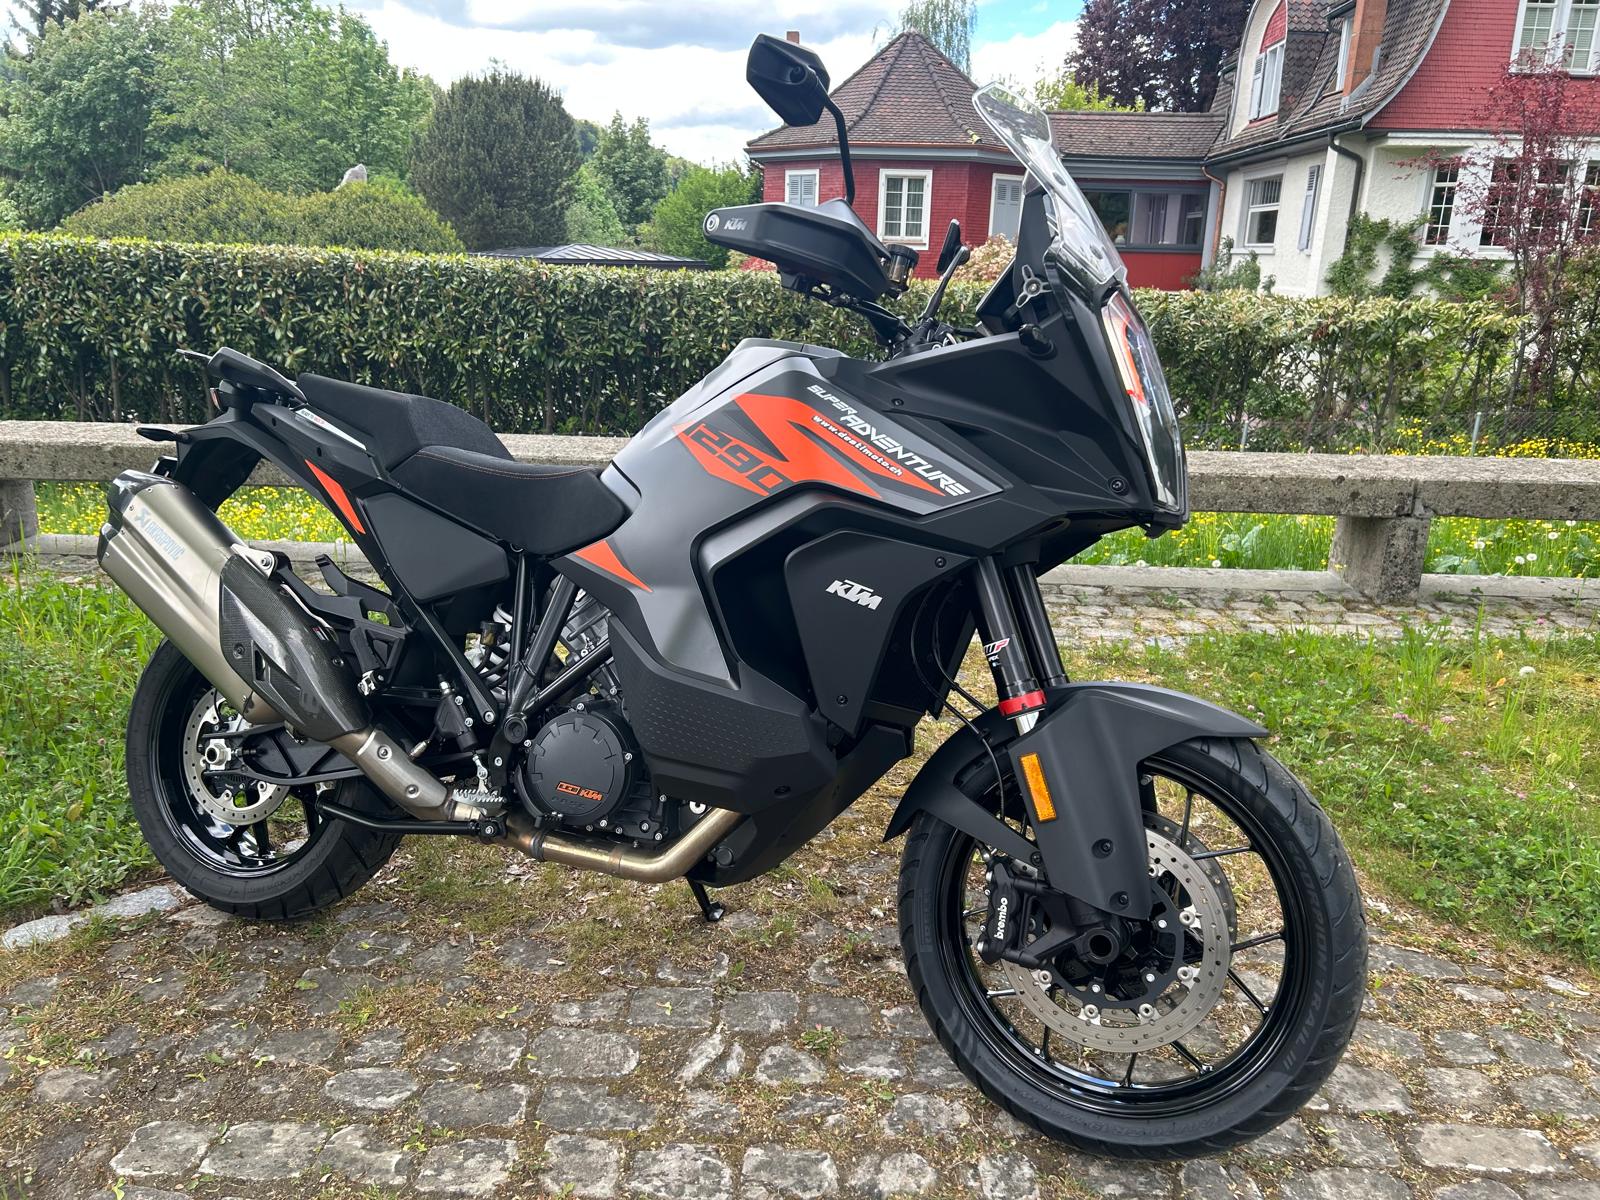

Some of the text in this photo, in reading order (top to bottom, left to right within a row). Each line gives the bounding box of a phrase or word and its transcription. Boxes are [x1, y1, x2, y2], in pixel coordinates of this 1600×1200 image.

[723, 218, 748, 231] KTM
[807, 385, 857, 415] SUPER
[687, 423, 795, 490] 1290
[840, 414, 972, 497] ADVENTURE
[826, 579, 883, 611] KTM
[580, 788, 603, 801] KTM
[994, 897, 1008, 940] brembo
[1296, 978, 1326, 1046] TRAIL
